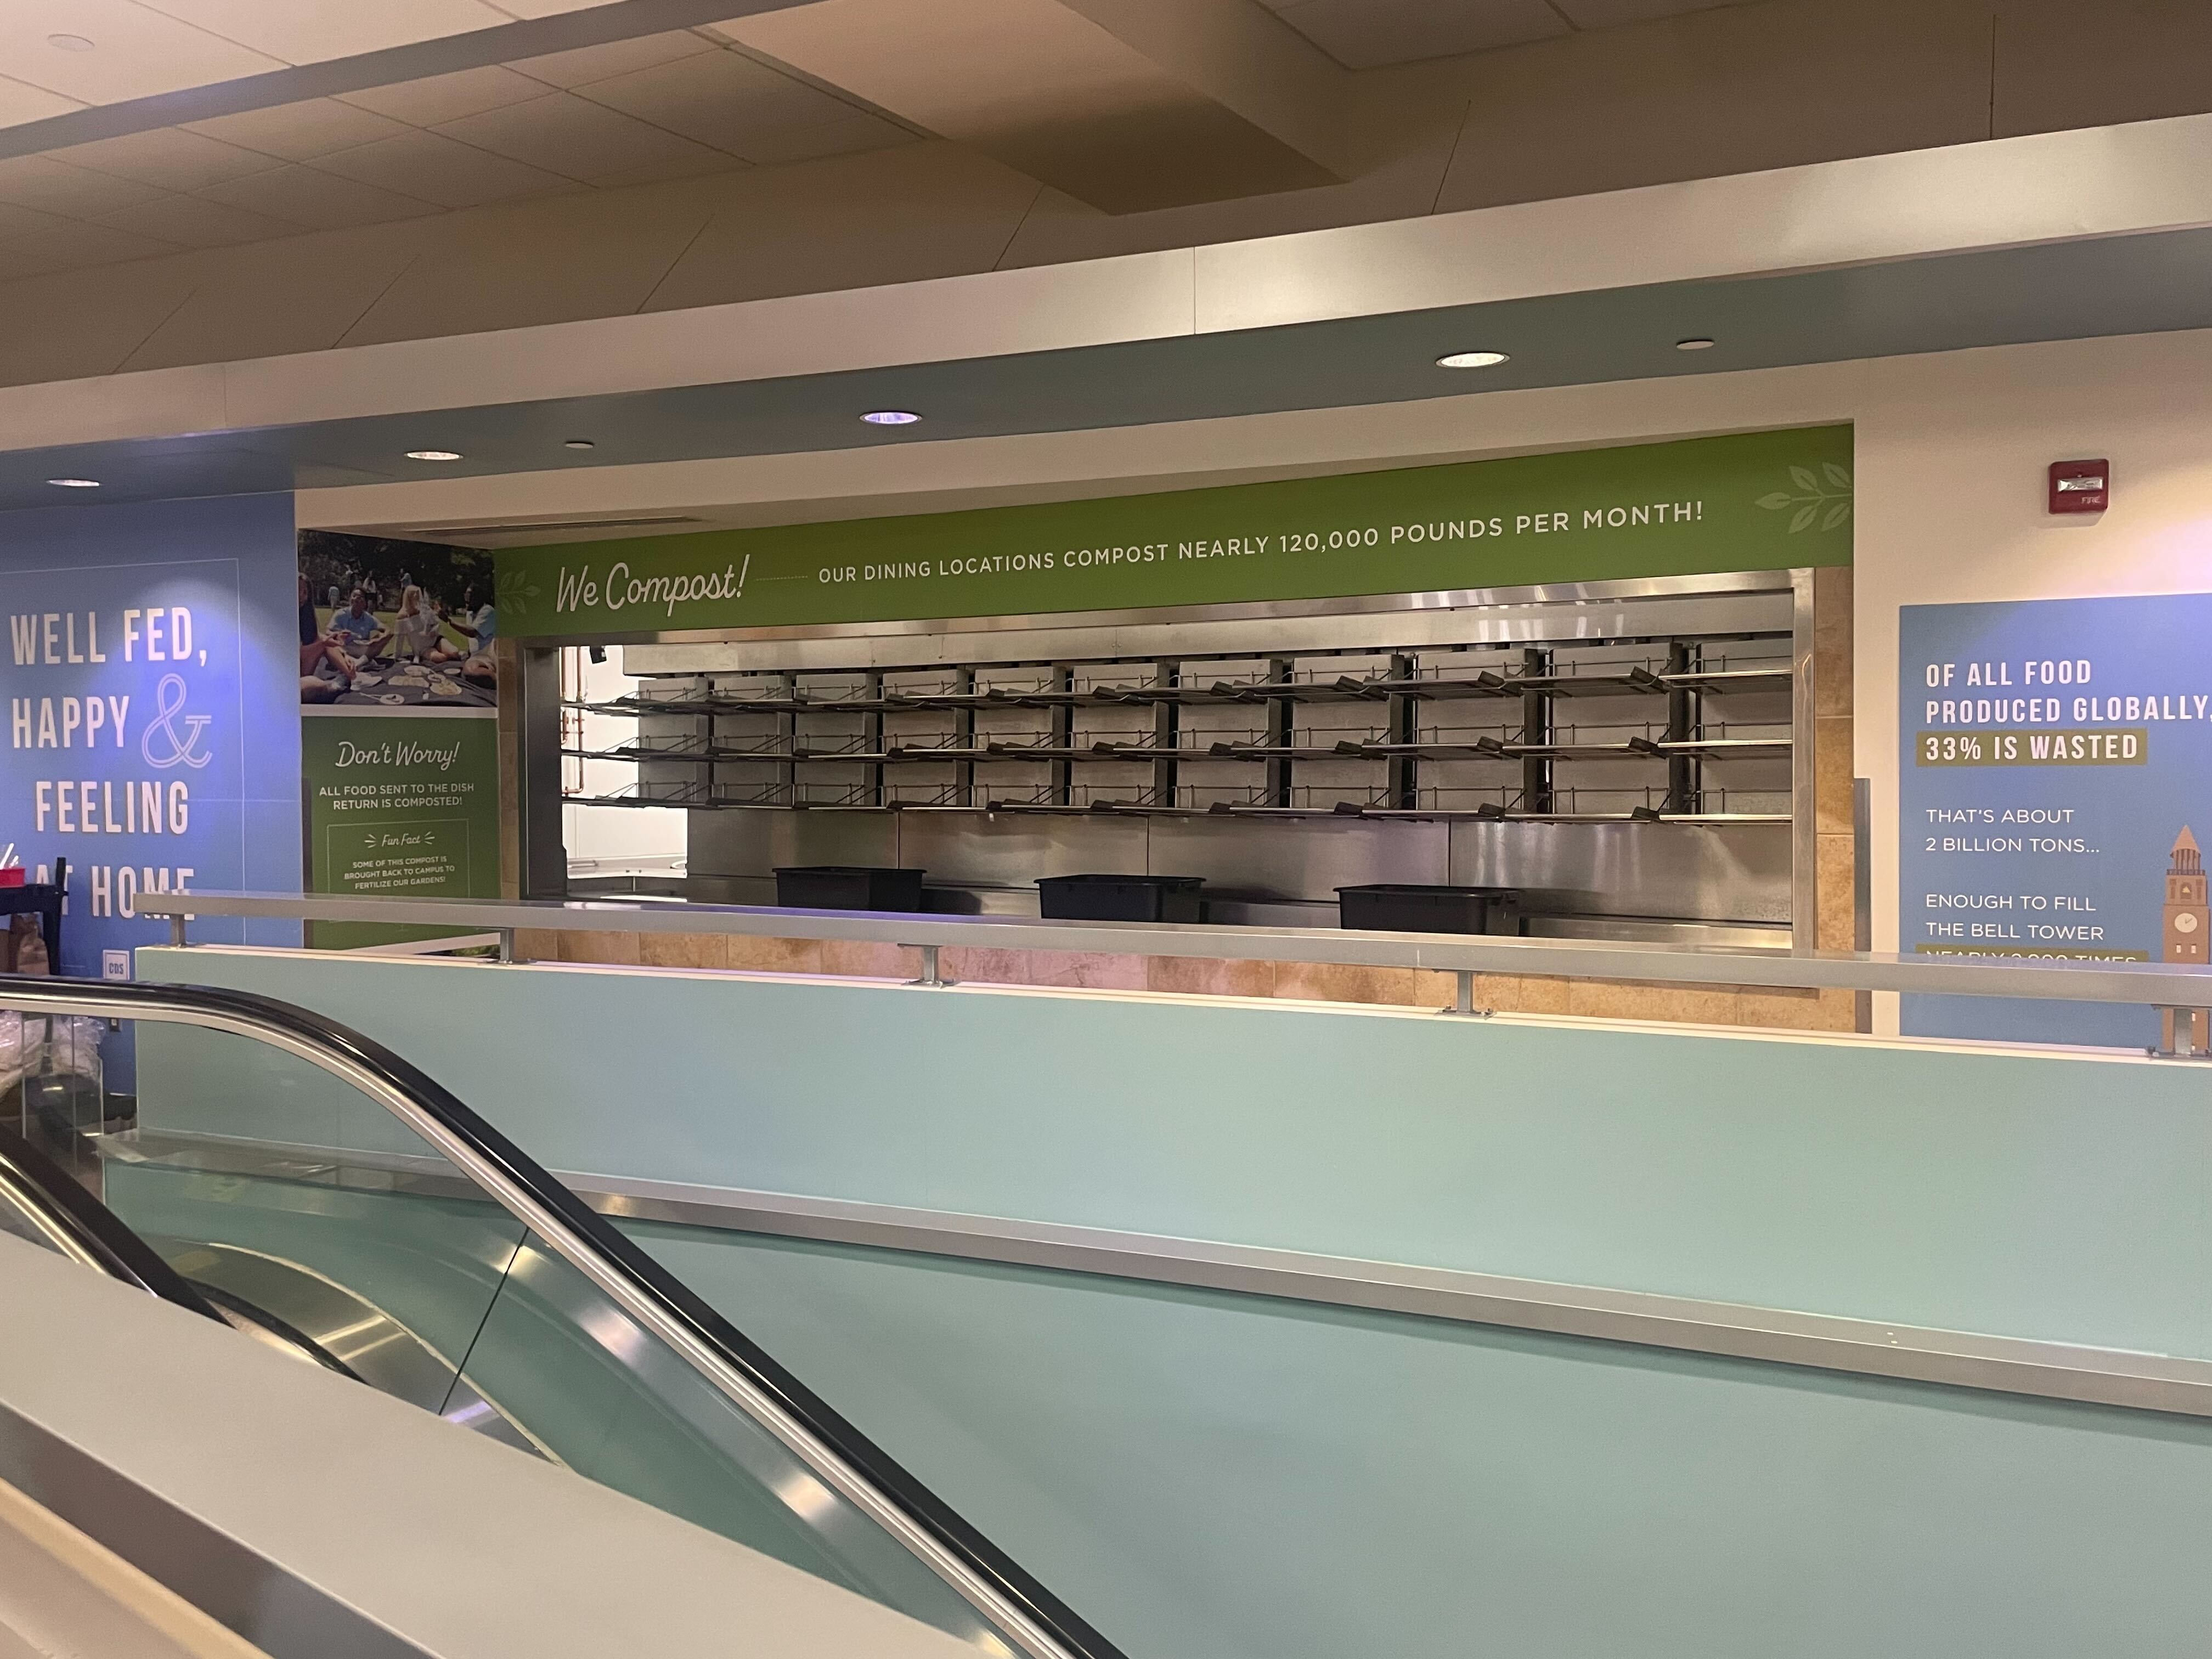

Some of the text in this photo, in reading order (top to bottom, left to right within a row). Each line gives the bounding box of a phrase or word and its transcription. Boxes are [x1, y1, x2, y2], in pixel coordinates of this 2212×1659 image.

[820, 501, 1701, 583] OUR DINING LOCATIONS COMPOST NEARLY 120,000 POUNDS PER MONTH!
[557, 554, 749, 617] We Compost!
[10, 607, 206, 667] WELL FED,
[1927, 661, 2090, 687] OF ALL FOOD
[1927, 698, 2059, 723] PRODUCED
[13, 673, 212, 768] HAPPY &
[335, 742, 460, 770] Don't Worry!
[1927, 735, 2136, 760] 33% IS WASTED
[319, 783, 473, 795] ALL FOOD SENT TO THE DISH
[37, 781, 188, 834] FEELING
[334, 797, 461, 810] RETURN IS COMPOSTED!
[1926, 810, 2074, 823] THAT'S ABOUT
[382, 833, 420, 847] Fun Fact
[1926, 838, 2099, 852] 2 BILLION TONS...
[344, 871, 380, 879] BROUGHT
[355, 880, 391, 889] FERTILIZE
[1927, 894, 2096, 911] ENOUGH TO FILL
[1926, 923, 2103, 940] THE BELL TOWER
[109, 963, 123, 974] CDS
